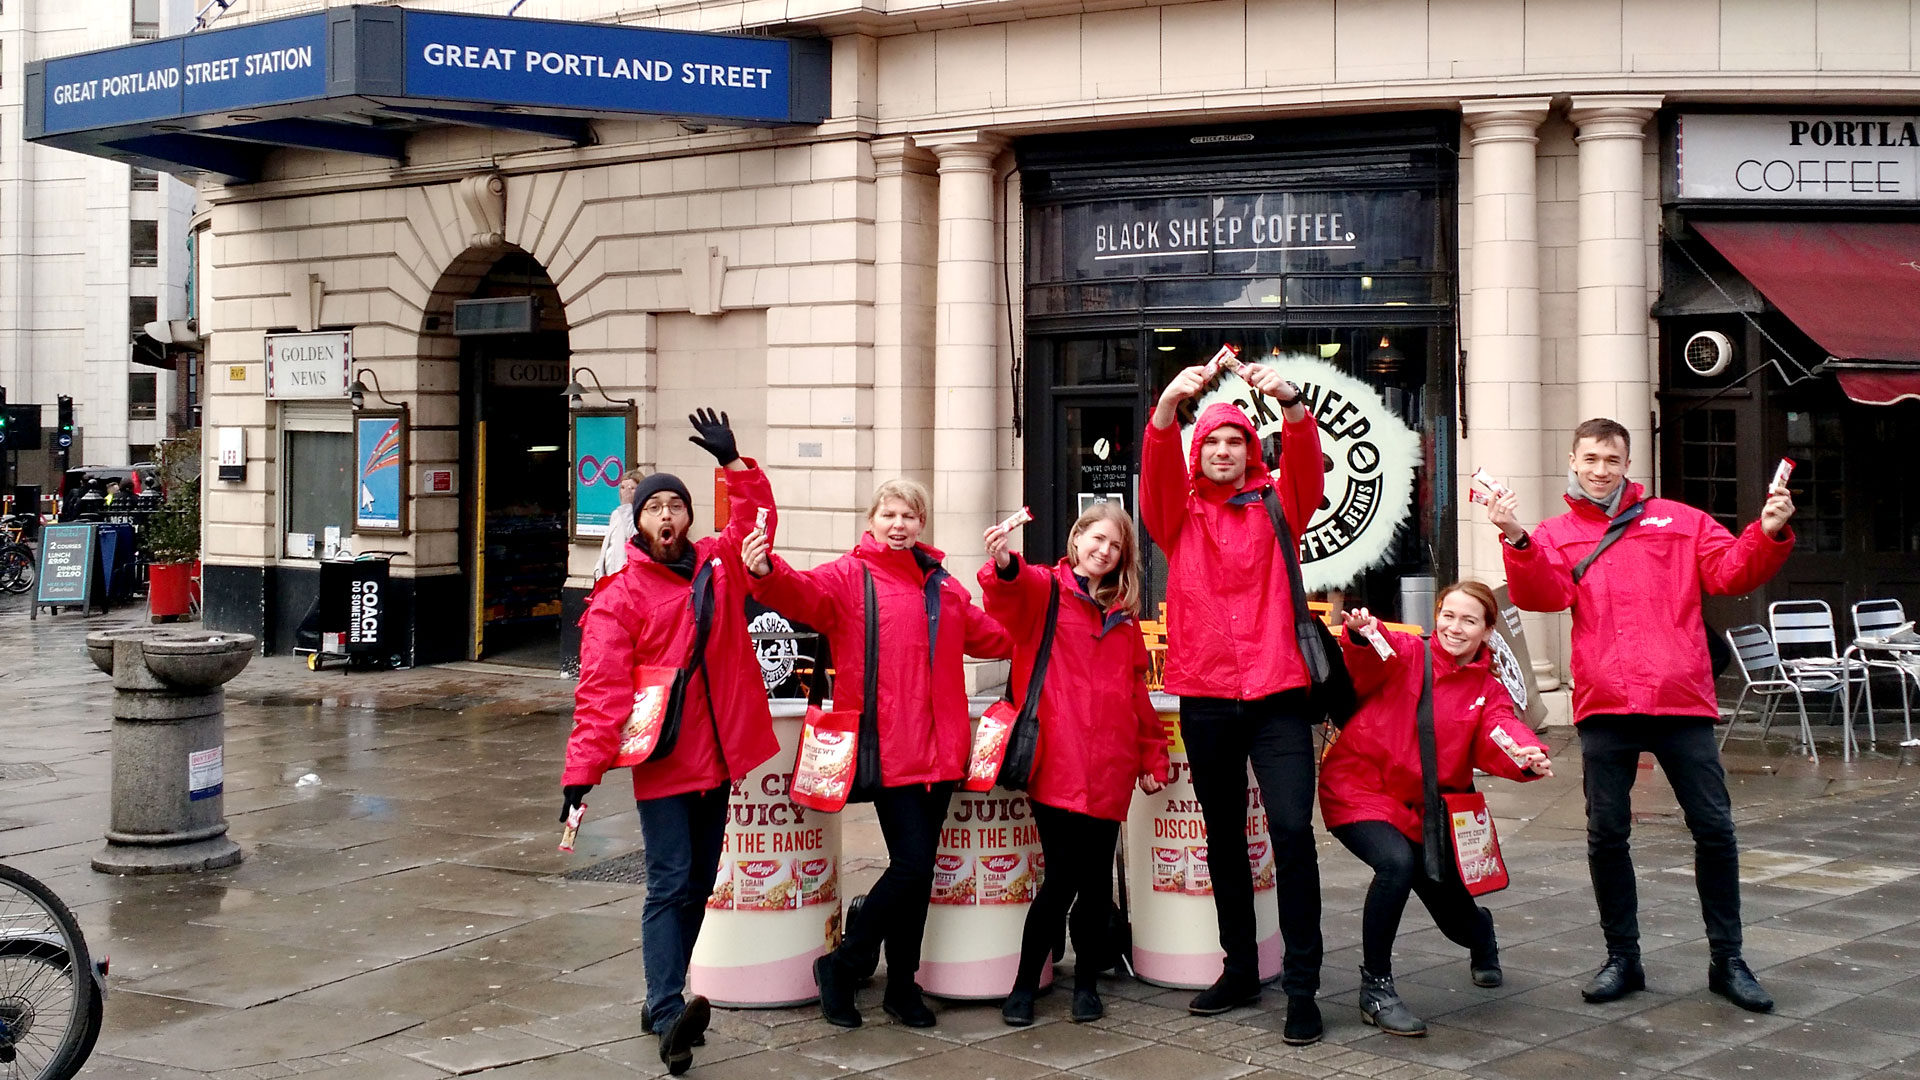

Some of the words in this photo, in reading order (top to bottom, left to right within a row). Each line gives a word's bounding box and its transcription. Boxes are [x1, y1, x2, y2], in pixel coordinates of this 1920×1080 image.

[54, 80, 97, 105] GREAT
[102, 67, 179, 98] PORTLAND
[185, 57, 240, 86] STREET
[245, 45, 312, 77] STATION
[423, 43, 516, 71] GREAT
[526, 51, 673, 82] PORTLAND
[681, 62, 772, 89] STREET
[1736, 159, 1900, 193] COFFEE
[1096, 220, 1160, 252] BLACK
[1168, 216, 1242, 248] SHEEP
[281, 345, 334, 362] GOLDEN
[231, 368, 244, 377] RVP
[291, 371, 327, 386] NEWS
[1303, 382, 1372, 442] HEEP
[223, 450, 236, 464] LFB
[1345, 484, 1373, 528] BEANS
[352, 580, 361, 593] DO
[350, 593, 361, 643] SOMETHING
[361, 580, 379, 643] COACH
[978, 828, 1007, 848] THE
[1013, 824, 1040, 847] RAN
[1154, 817, 1208, 840] DISCOV
[736, 833, 766, 853] THE
[773, 828, 823, 853] RANGE
[746, 863, 774, 876] Kellogg's
[935, 872, 957, 880] NUTTY
[988, 873, 1007, 881] GRAIN
[745, 879, 764, 887] GRAIN
